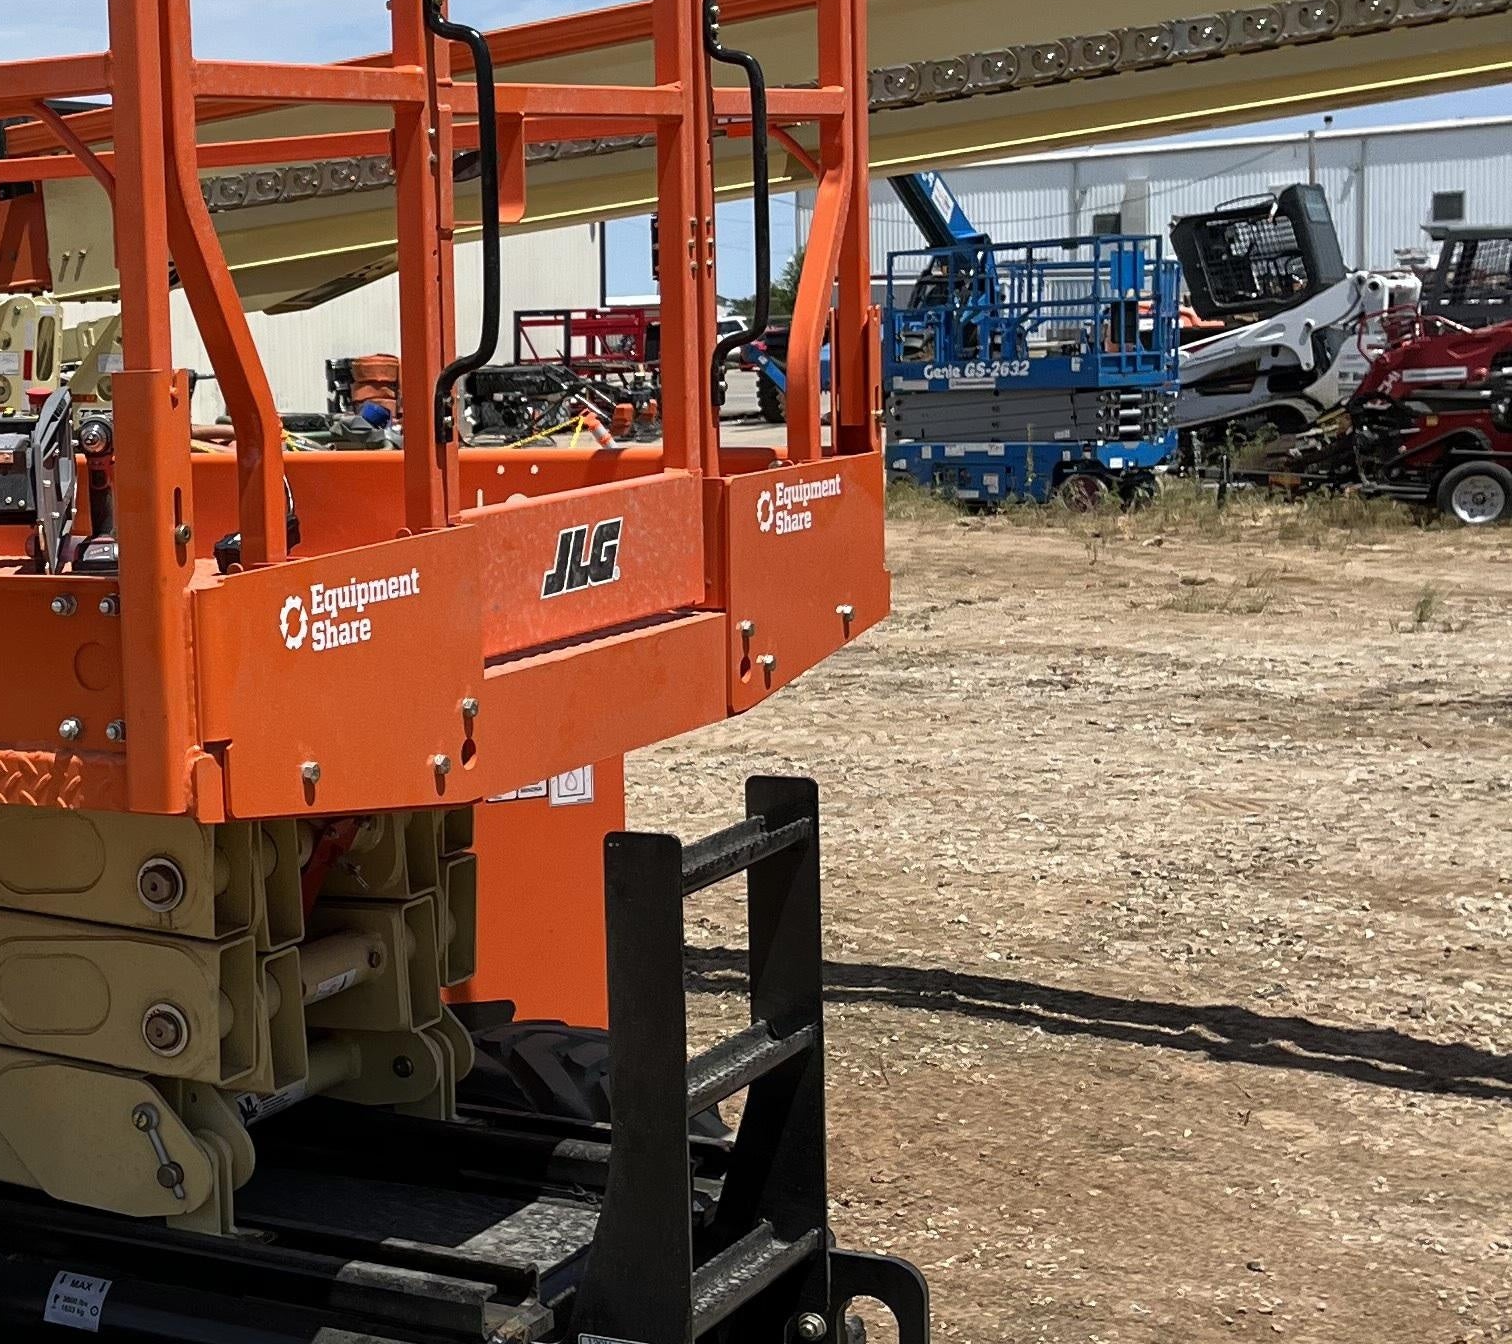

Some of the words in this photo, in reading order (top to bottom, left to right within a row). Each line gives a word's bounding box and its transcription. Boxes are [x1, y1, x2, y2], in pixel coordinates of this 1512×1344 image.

[923, 363, 961, 379] Genie
[964, 359, 1030, 378] GS-2632
[775, 473, 842, 509] Equipment
[775, 509, 813, 535] Share
[541, 516, 623, 600] JLG
[310, 567, 420, 616] Equipment
[311, 618, 372, 652] Share
[70, 1279, 93, 1291] MAX
